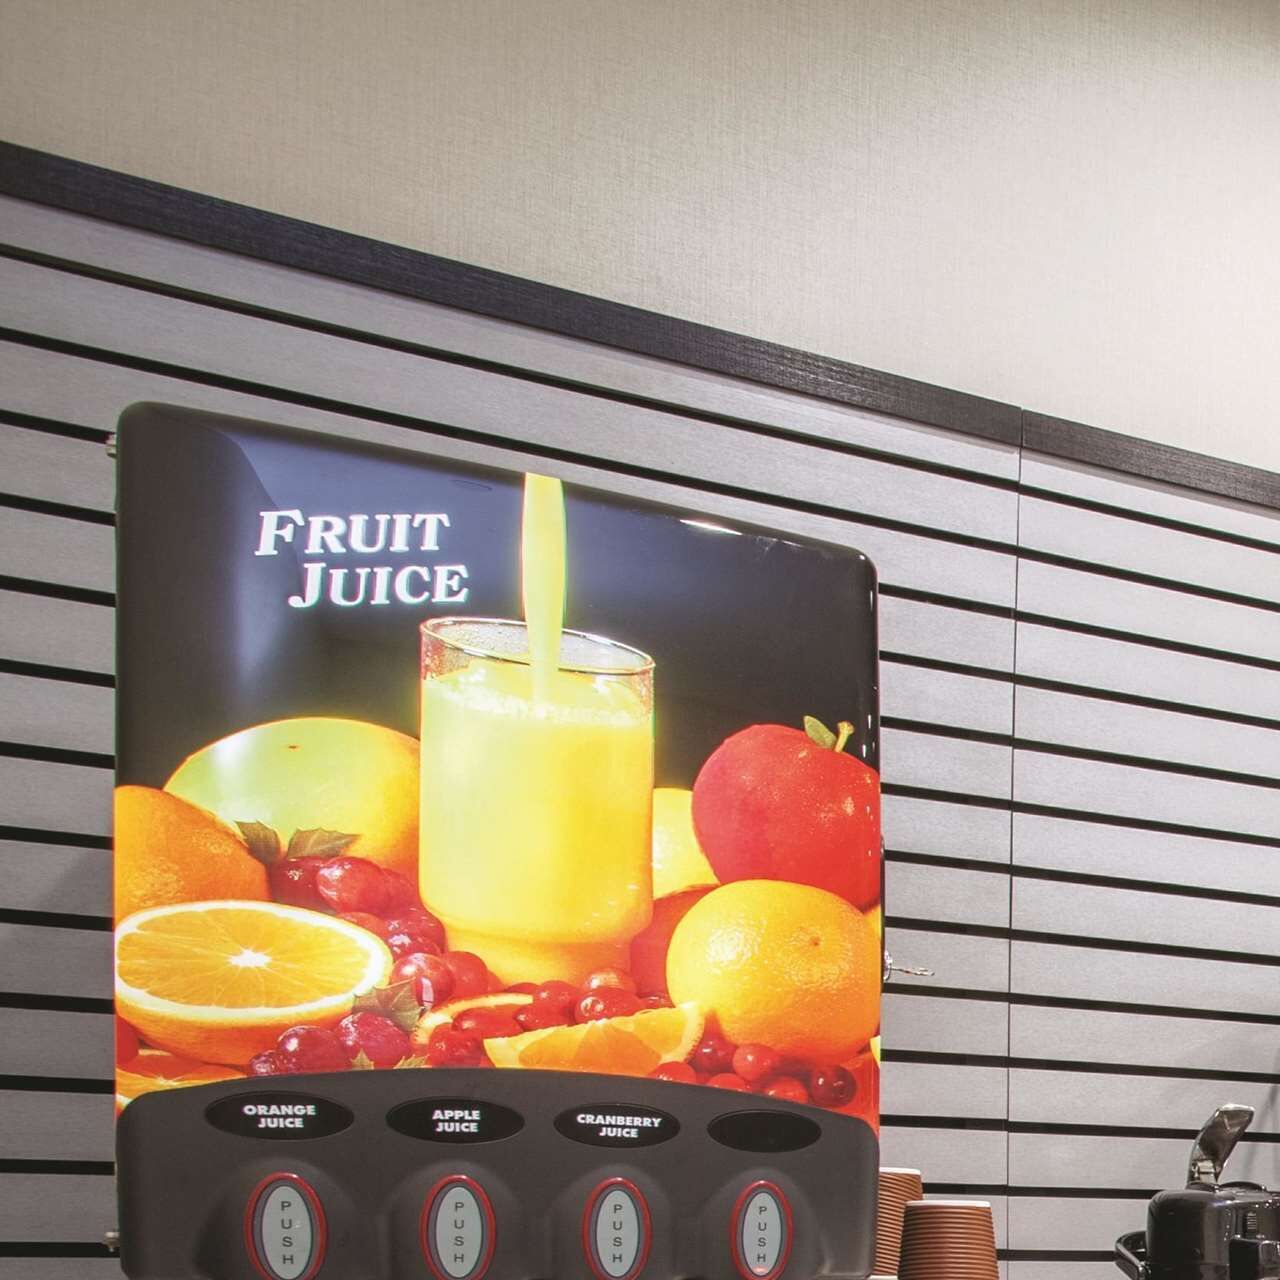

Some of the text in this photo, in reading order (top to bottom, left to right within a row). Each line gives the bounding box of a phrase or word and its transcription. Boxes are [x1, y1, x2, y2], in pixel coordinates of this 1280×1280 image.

[254, 509, 451, 556] FRUIT
[288, 562, 469, 608] JUICE
[242, 1104, 316, 1116] ORANGE
[257, 1117, 304, 1129] JUICE
[431, 1109, 481, 1121] APPLE
[576, 1113, 662, 1129] CRANBERRY
[435, 1121, 478, 1133] JUICE
[598, 1126, 639, 1138] JUICE
[279, 1200, 295, 1265] PUSH
[453, 1202, 465, 1263] PUSH
[611, 1203, 623, 1263] PUSH
[756, 1206, 768, 1263] PUSH
